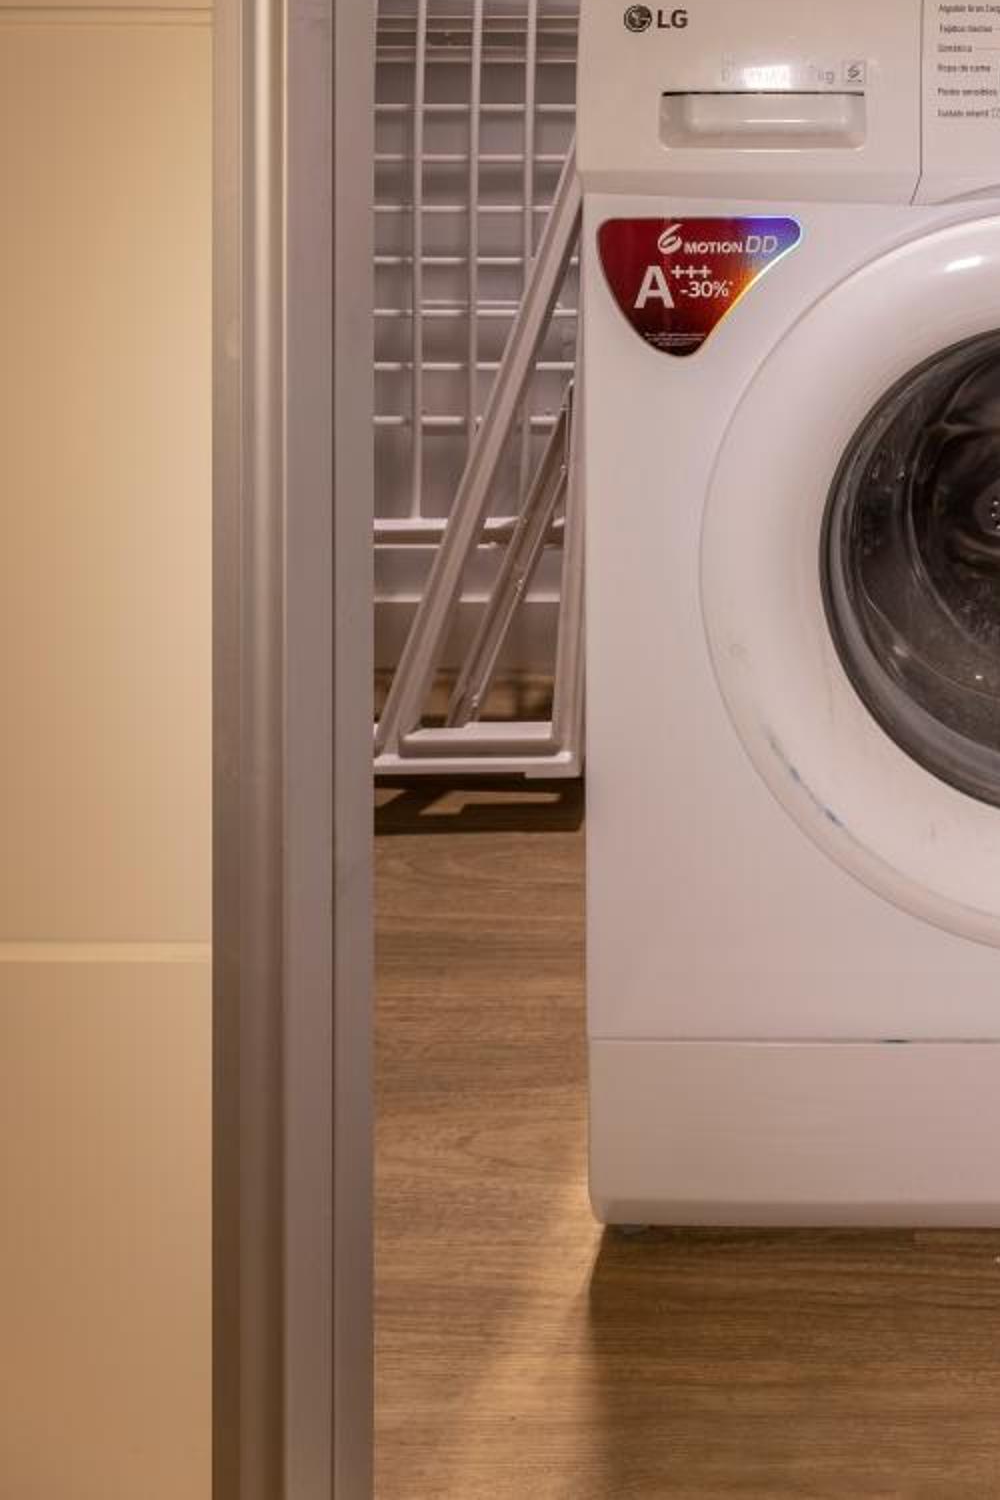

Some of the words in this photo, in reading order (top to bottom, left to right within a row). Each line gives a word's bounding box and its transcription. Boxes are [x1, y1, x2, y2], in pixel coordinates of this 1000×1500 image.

[657, 9, 689, 29] LG
[657, 223, 683, 254] 6
[684, 241, 743, 253] MOTION
[745, 235, 778, 253] DD
